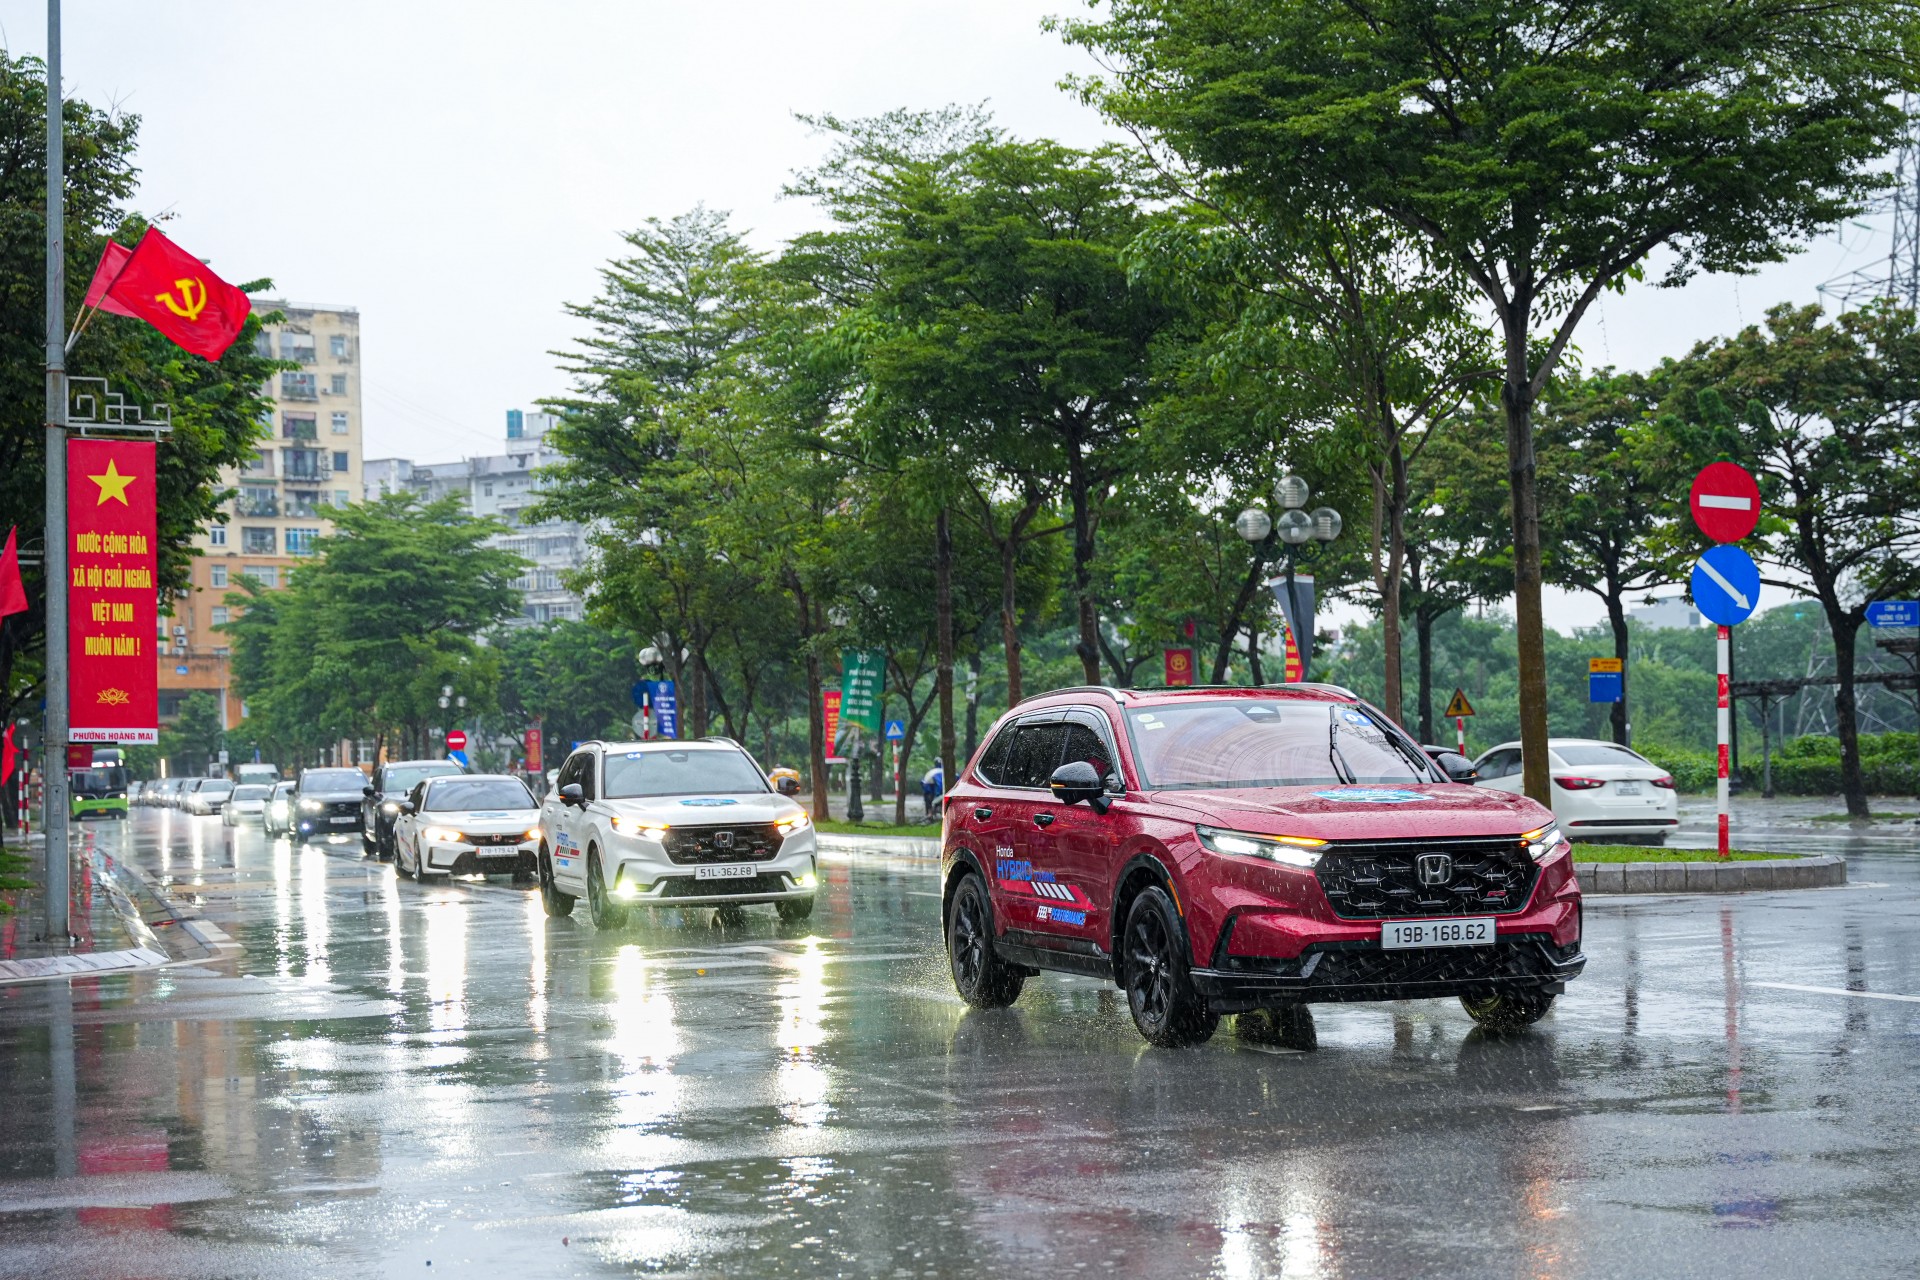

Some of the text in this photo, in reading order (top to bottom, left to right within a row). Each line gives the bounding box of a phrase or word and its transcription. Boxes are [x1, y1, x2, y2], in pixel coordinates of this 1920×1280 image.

[77, 530, 148, 558] NƯỚC CỘNG HÒA
[73, 562, 152, 592] XÃ HỘI CHỦ NGHĨA
[91, 598, 134, 626] VIỆT NAM
[85, 632, 112, 656] MUÔN
[113, 633, 135, 656] NĂM
[1345, 712, 1369, 724] 01
[73, 731, 154, 740] PHƯỜNG HOÀNG MAI
[996, 845, 1014, 858] Honda
[700, 866, 752, 878] 51L-362.68
[996, 859, 1033, 881] HYBRID
[1394, 923, 1486, 944] 19B-168.62
